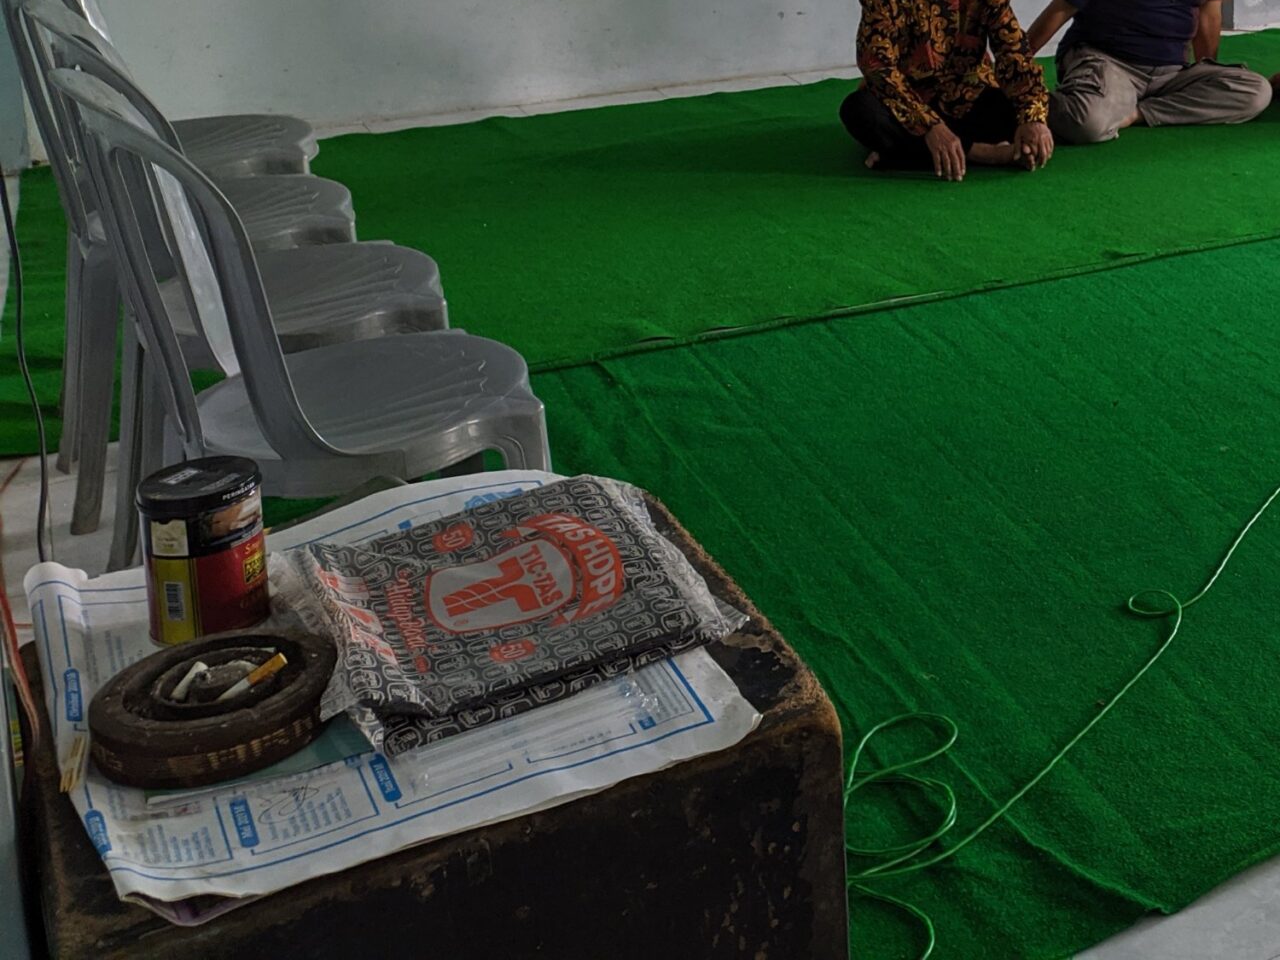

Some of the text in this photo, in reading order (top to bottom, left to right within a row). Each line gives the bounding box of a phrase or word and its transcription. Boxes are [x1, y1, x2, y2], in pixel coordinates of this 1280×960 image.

[441, 528, 464, 549] 50
[536, 514, 597, 541] TAS
[517, 543, 564, 607] TIC-TAS
[500, 641, 526, 660] 50
